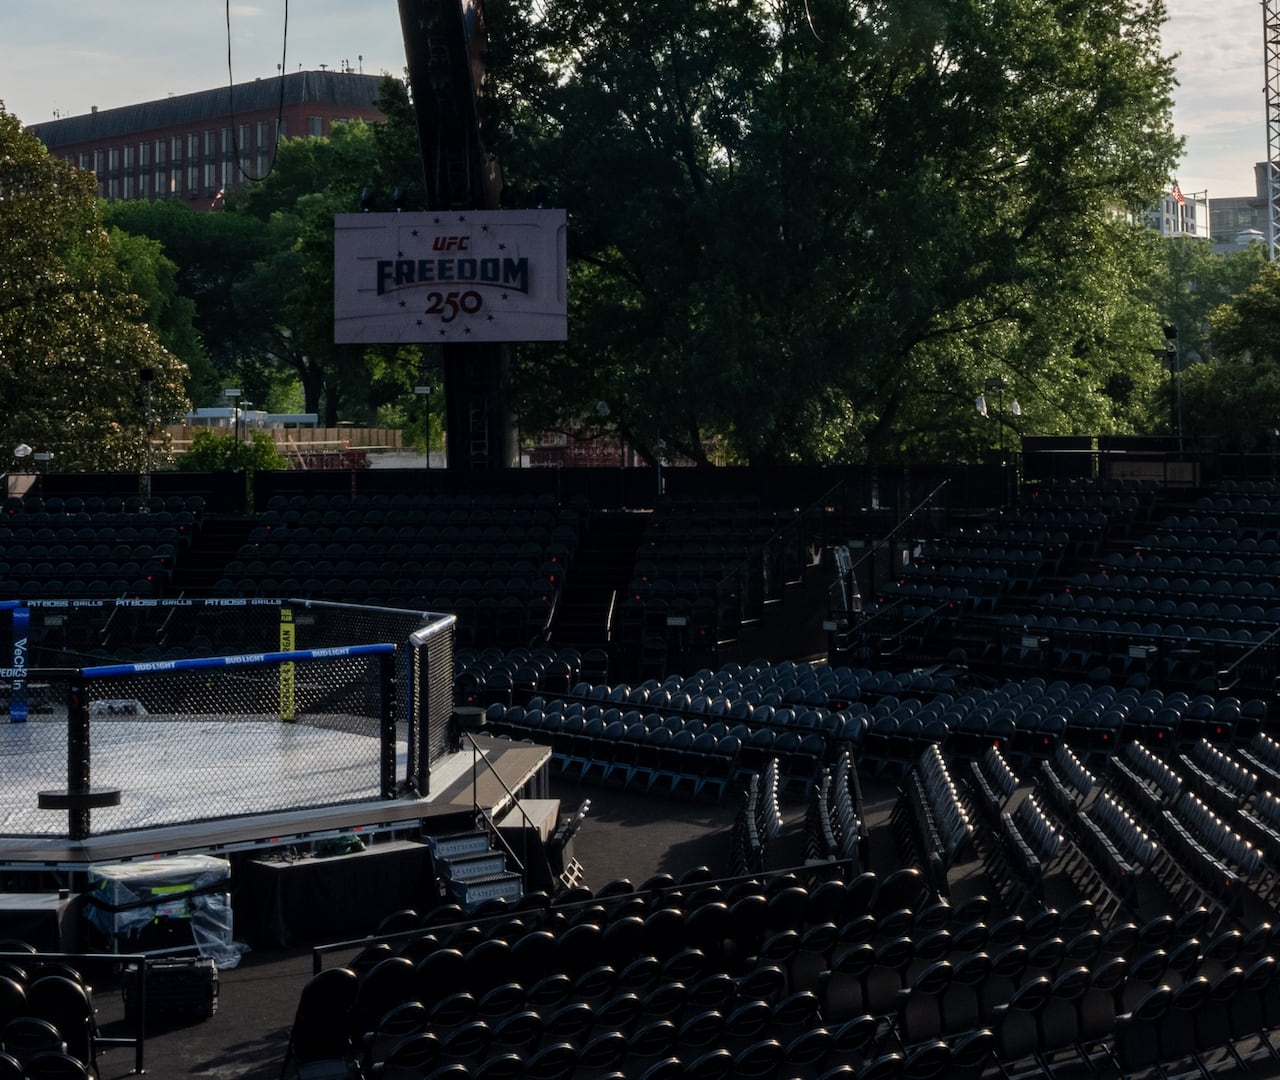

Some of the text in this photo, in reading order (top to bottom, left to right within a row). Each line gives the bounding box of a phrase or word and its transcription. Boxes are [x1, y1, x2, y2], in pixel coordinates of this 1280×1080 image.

[432, 236, 470, 251] UFC
[377, 257, 529, 297] FREEDOM
[424, 290, 483, 323] 250
[242, 655, 265, 663] LIGHT
[311, 648, 350, 658] BUD LIGHT
[13, 637, 27, 690] VeChin
[134, 662, 175, 671] BUD LIGHT
